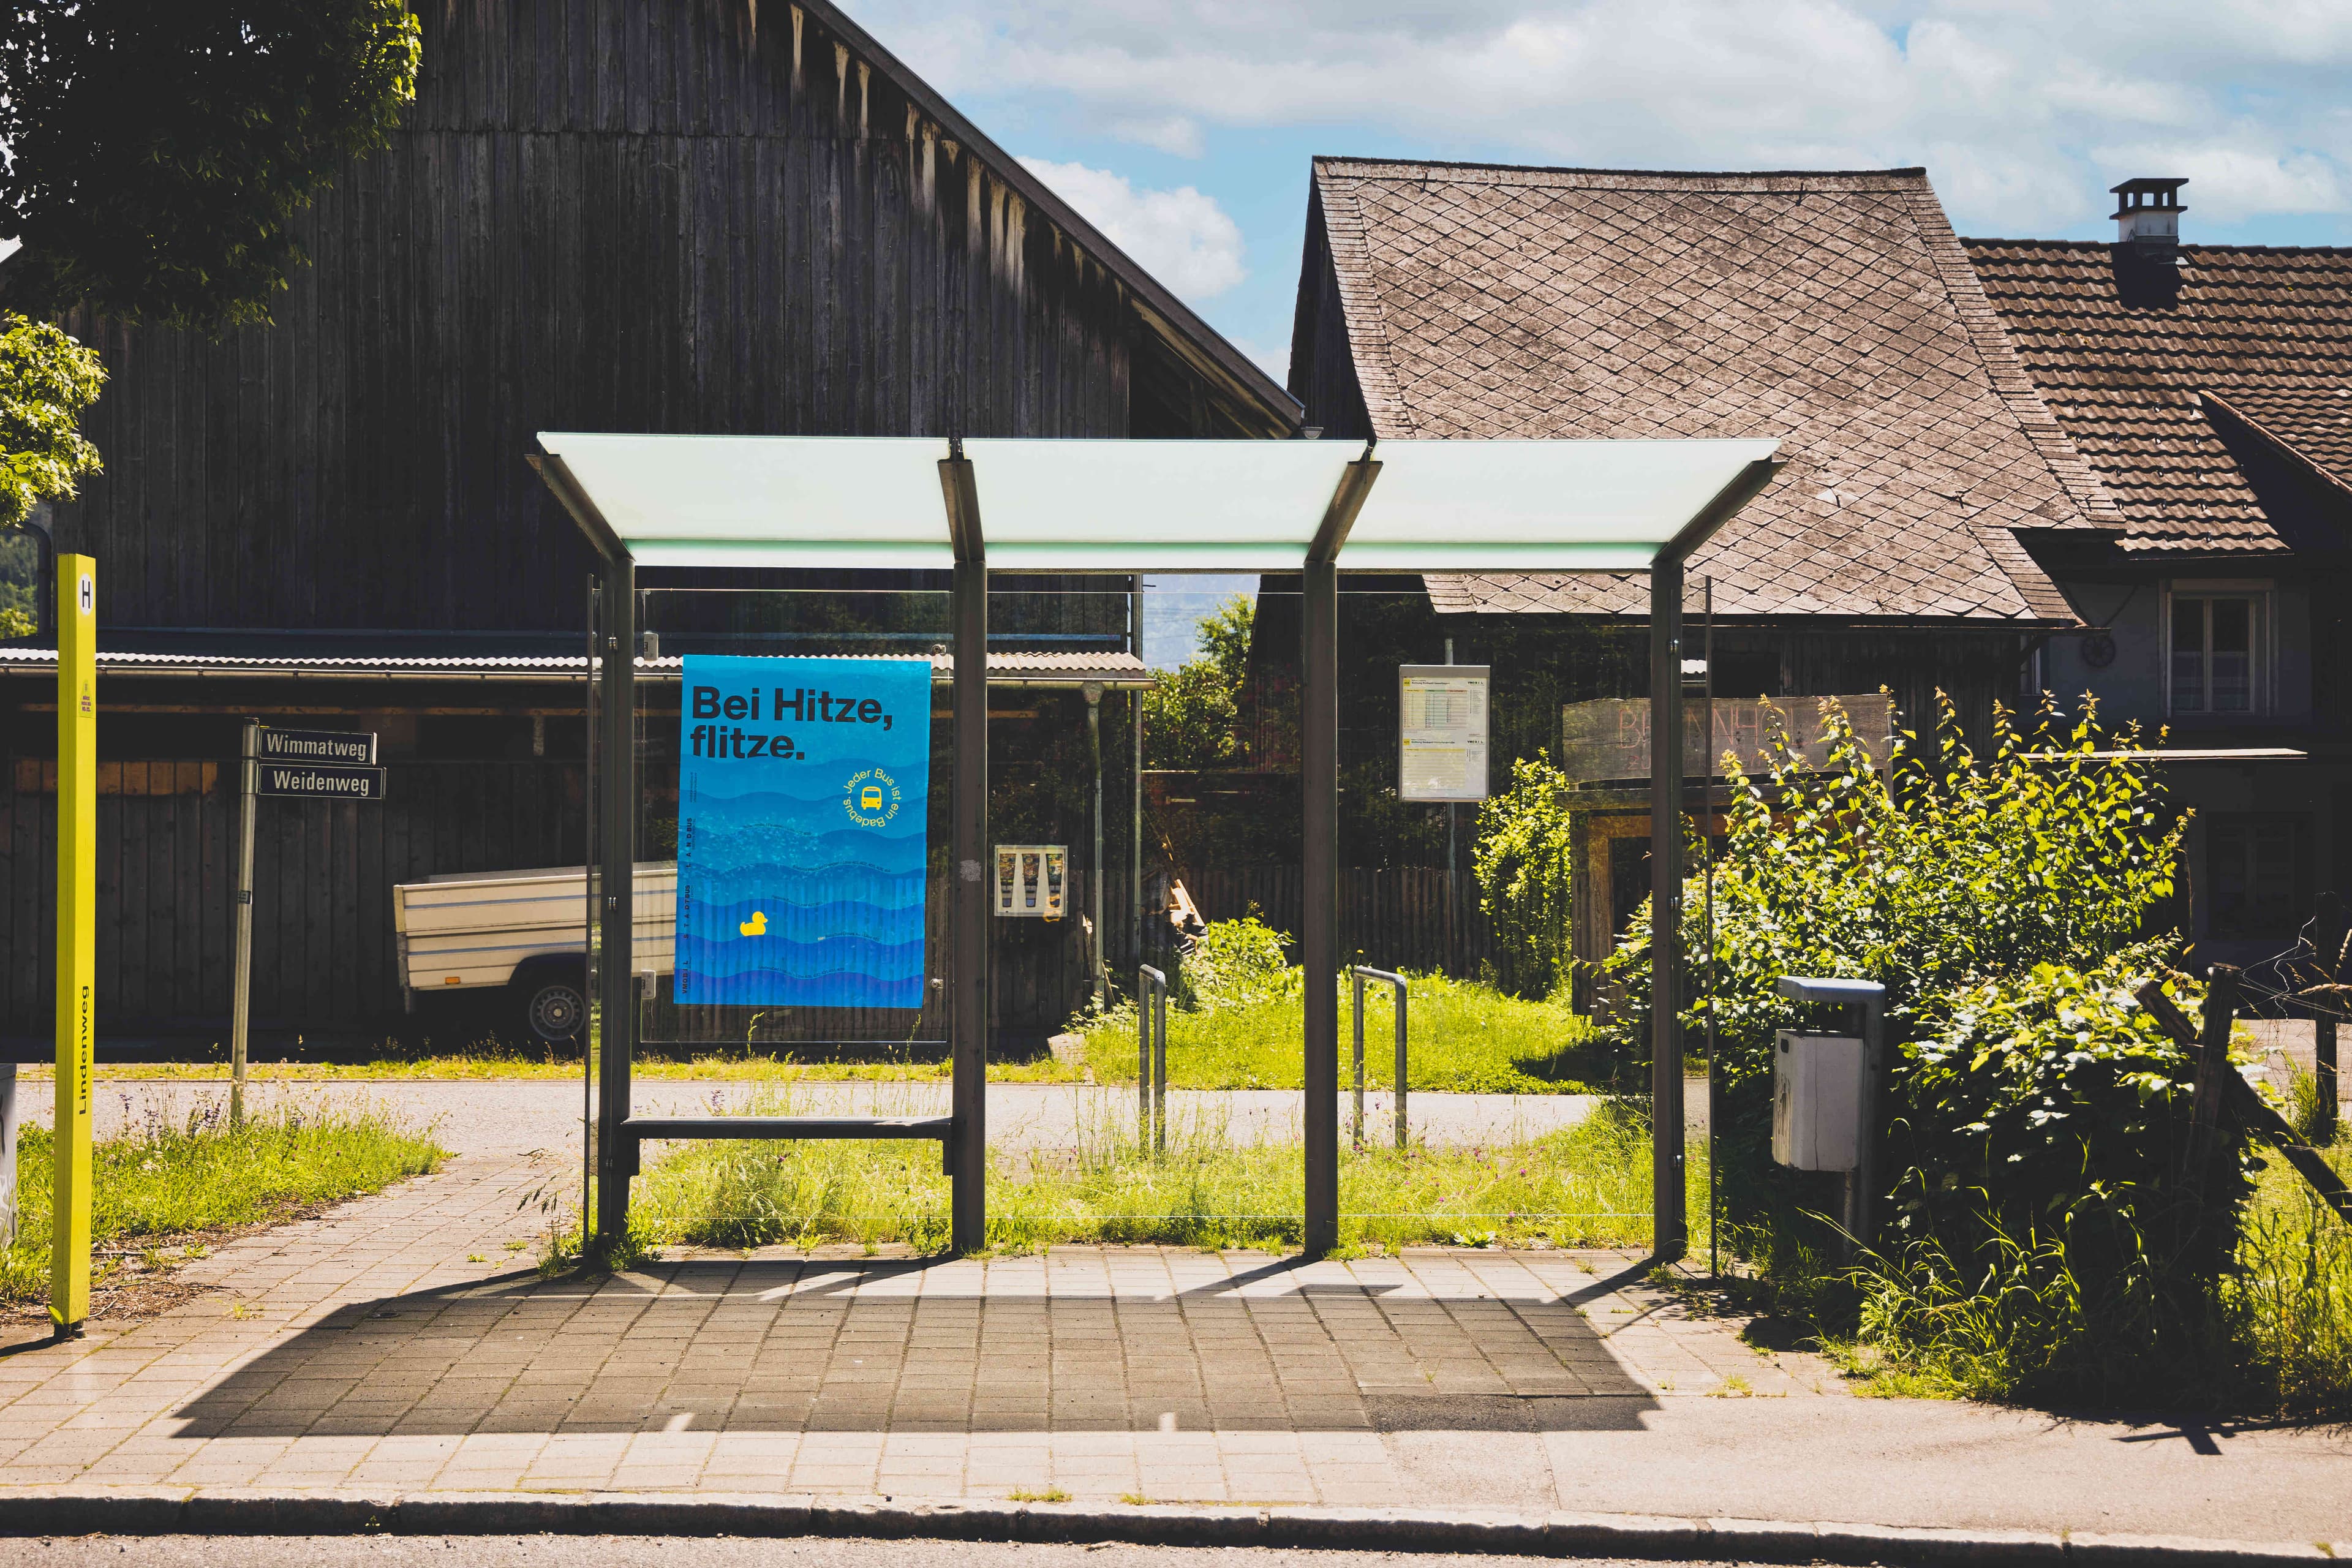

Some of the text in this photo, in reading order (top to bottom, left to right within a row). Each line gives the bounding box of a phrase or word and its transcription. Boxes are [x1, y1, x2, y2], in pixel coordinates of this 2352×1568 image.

[82, 580, 90, 608] H
[693, 686, 893, 731] Bei Hitze,
[267, 734, 367, 761] Wimmatweg
[690, 725, 805, 760] flitze.
[274, 770, 369, 796] Weidenweg
[843, 768, 902, 827] Jeder Bus ist ein Badebus.
[79, 985, 89, 1115] Lindenweg
